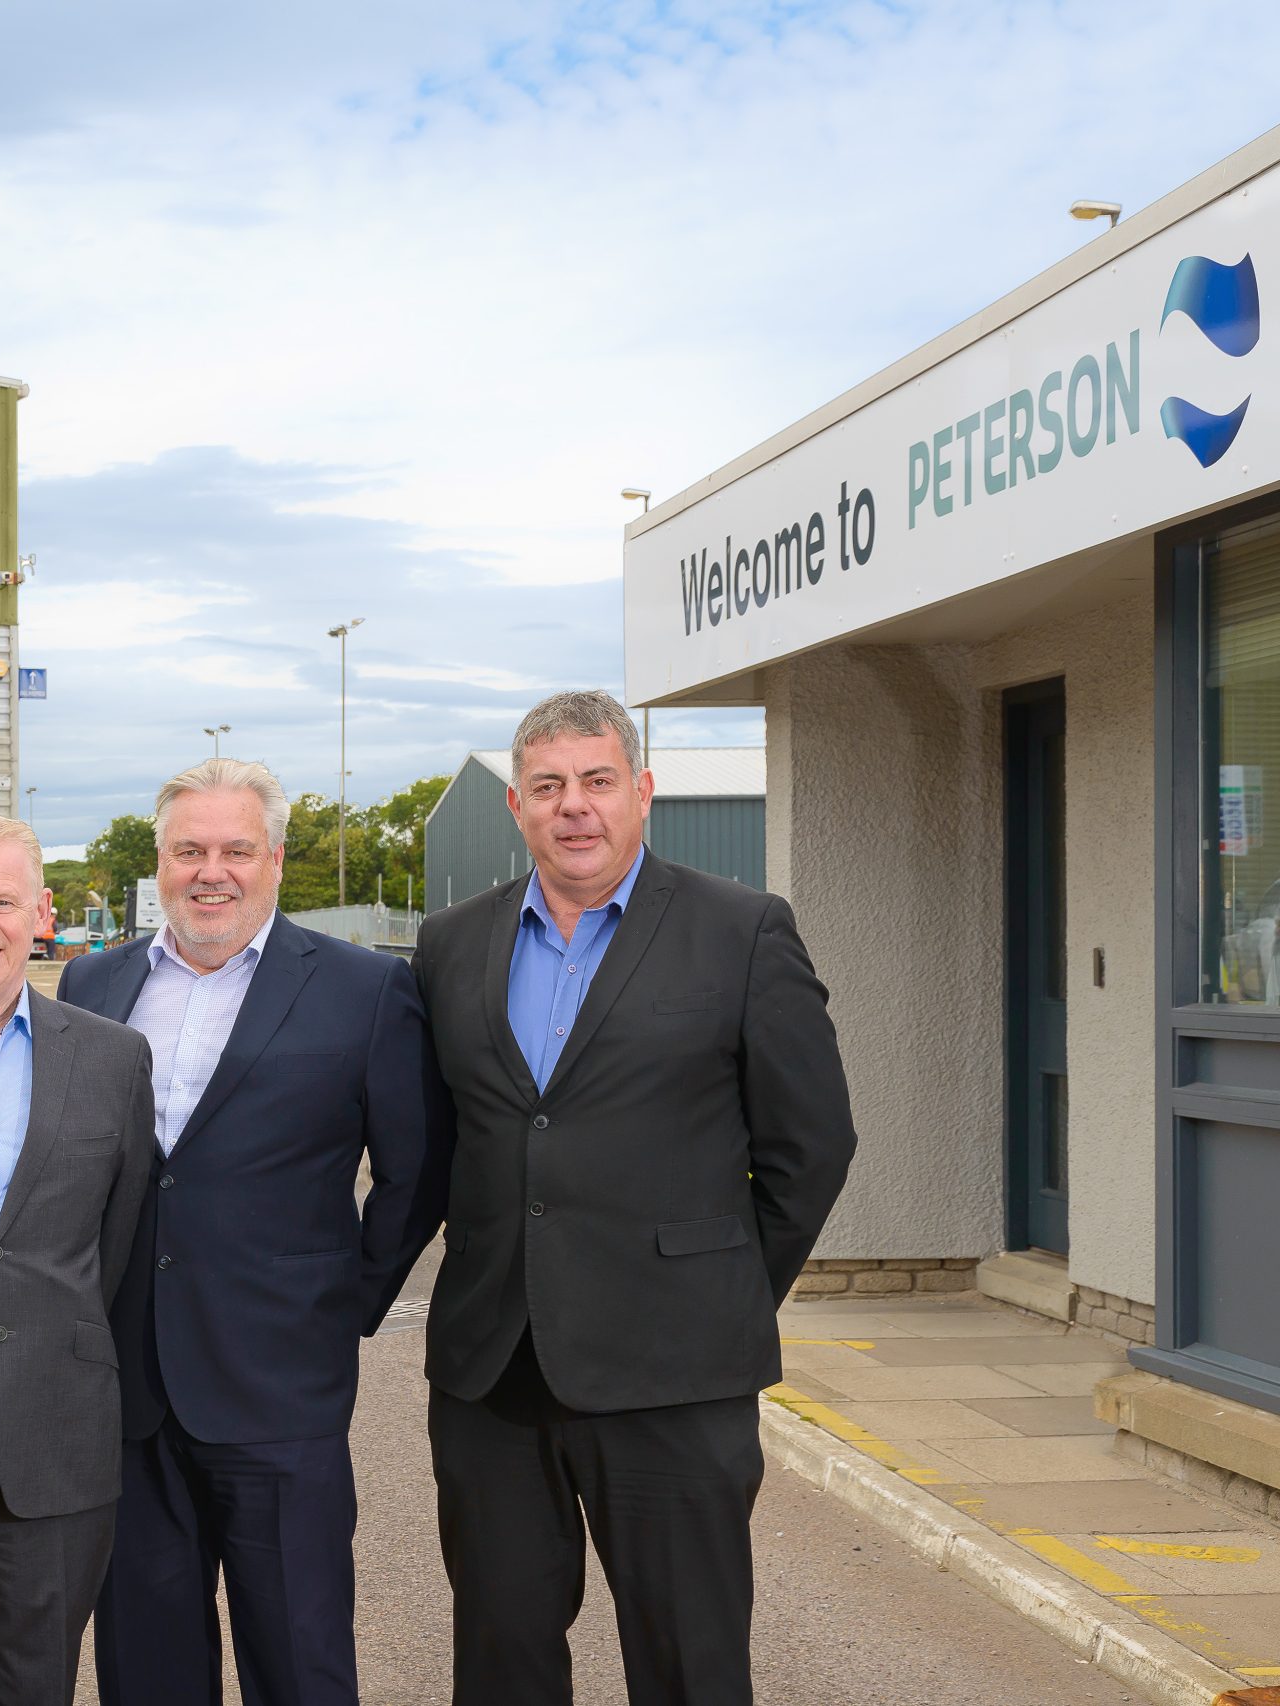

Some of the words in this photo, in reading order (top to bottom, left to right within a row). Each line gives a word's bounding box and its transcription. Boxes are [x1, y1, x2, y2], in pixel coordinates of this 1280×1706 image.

[679, 510, 826, 638] Welcome
[836, 480, 876, 573] to
[907, 328, 1141, 531] PETERSON
